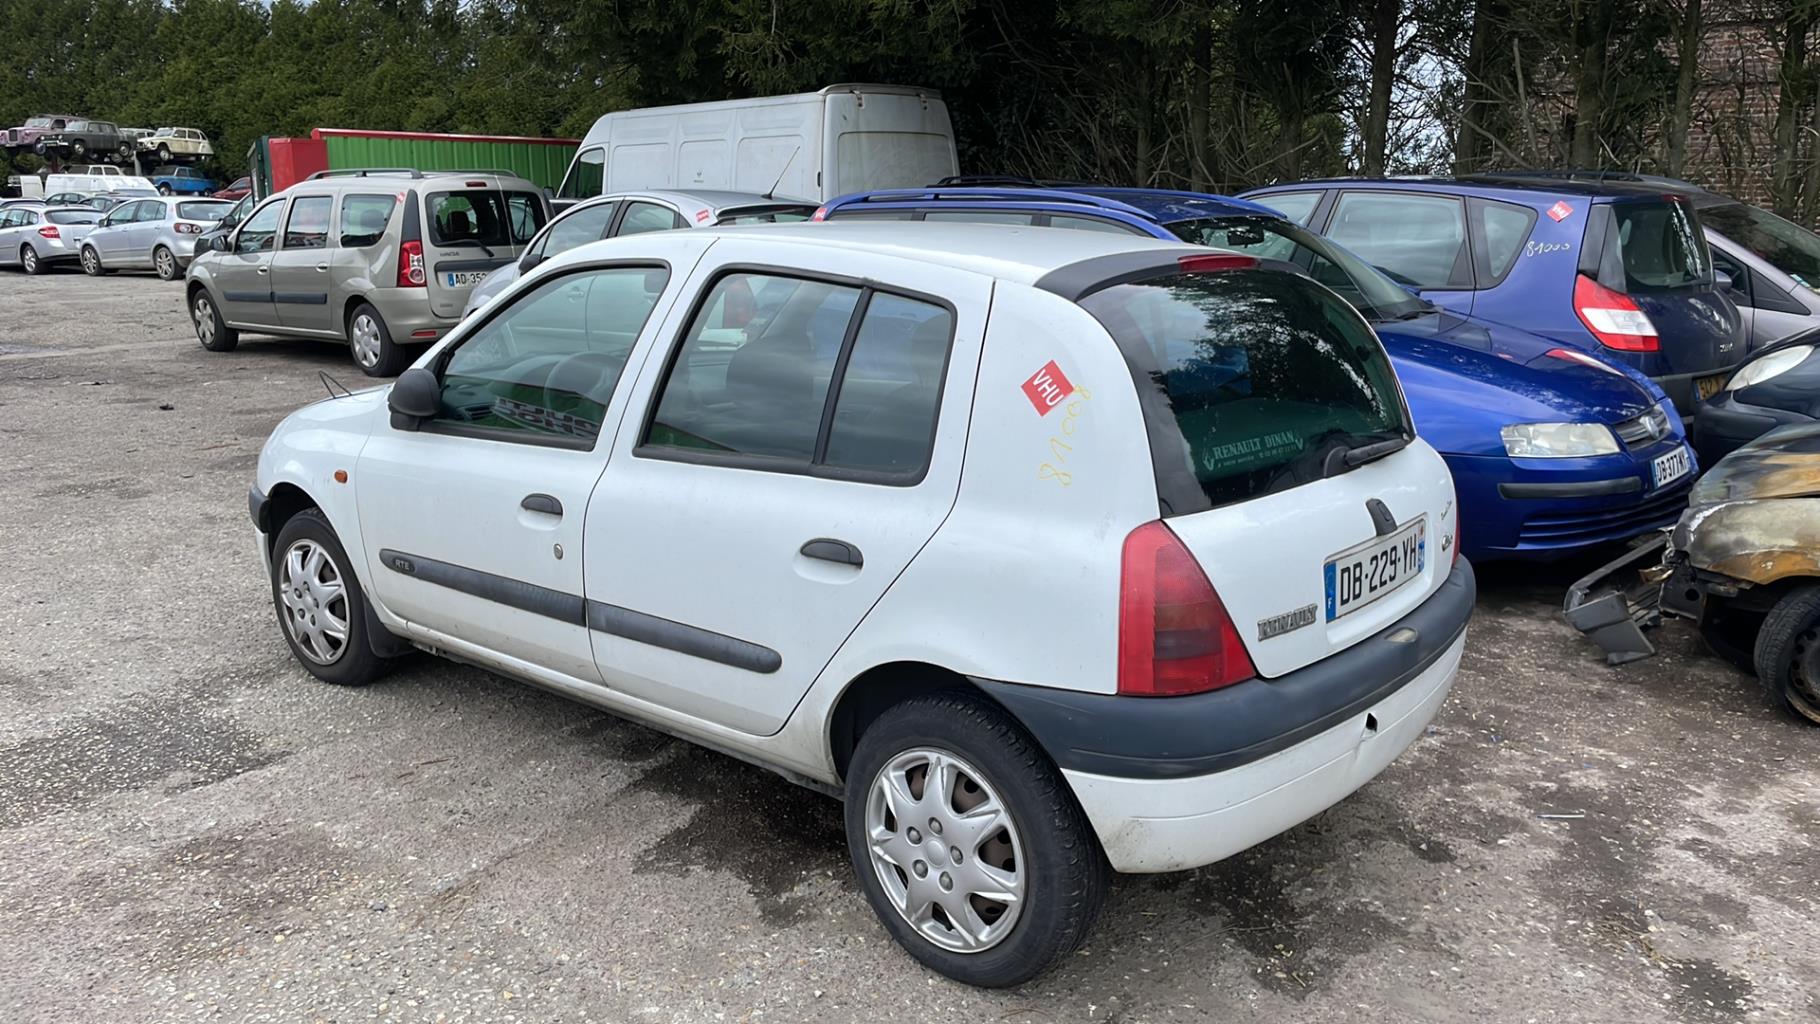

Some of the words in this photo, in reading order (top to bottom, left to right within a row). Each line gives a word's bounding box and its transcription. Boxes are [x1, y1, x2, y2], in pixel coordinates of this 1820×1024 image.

[1032, 369, 1065, 407] VHU
[1212, 438, 1261, 460] RENAULT
[1263, 430, 1295, 449] DINAN
[1340, 533, 1417, 606] DB-229-YH
